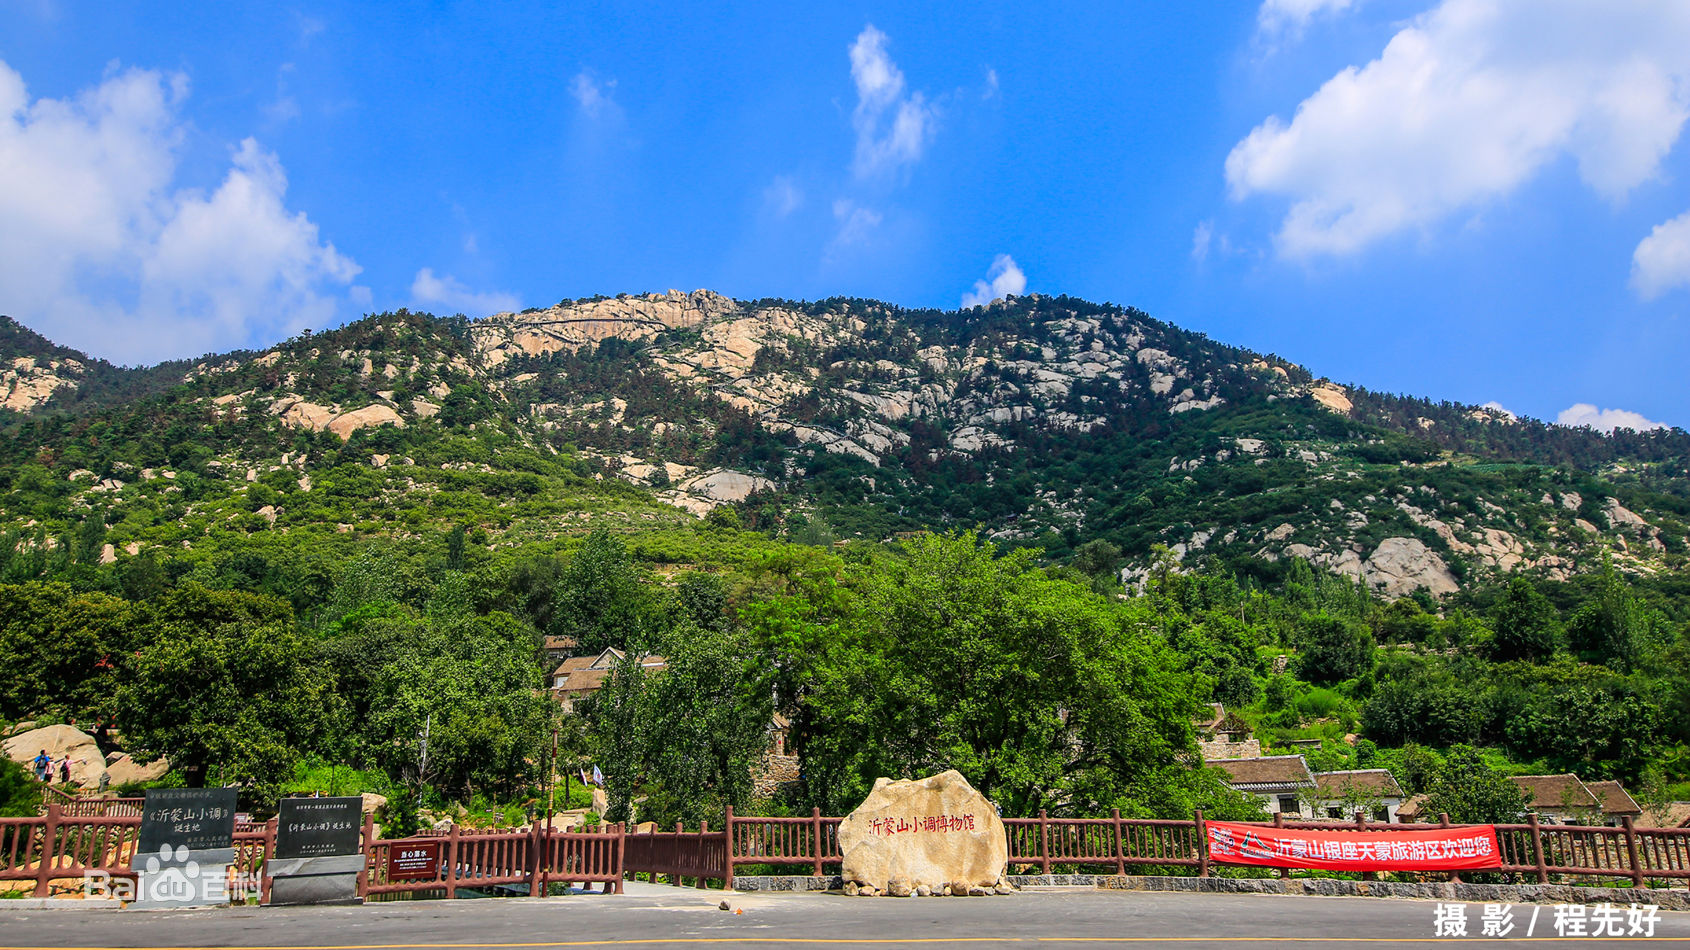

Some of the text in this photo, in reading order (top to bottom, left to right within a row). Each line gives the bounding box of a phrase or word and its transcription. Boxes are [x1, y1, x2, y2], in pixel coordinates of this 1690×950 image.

[174, 823, 201, 833] 诞生地
[868, 813, 975, 837] 沂蒙山小调博物馆
[1273, 836, 1492, 862] 沂蒙山银座天蒙旅游区欢迎您
